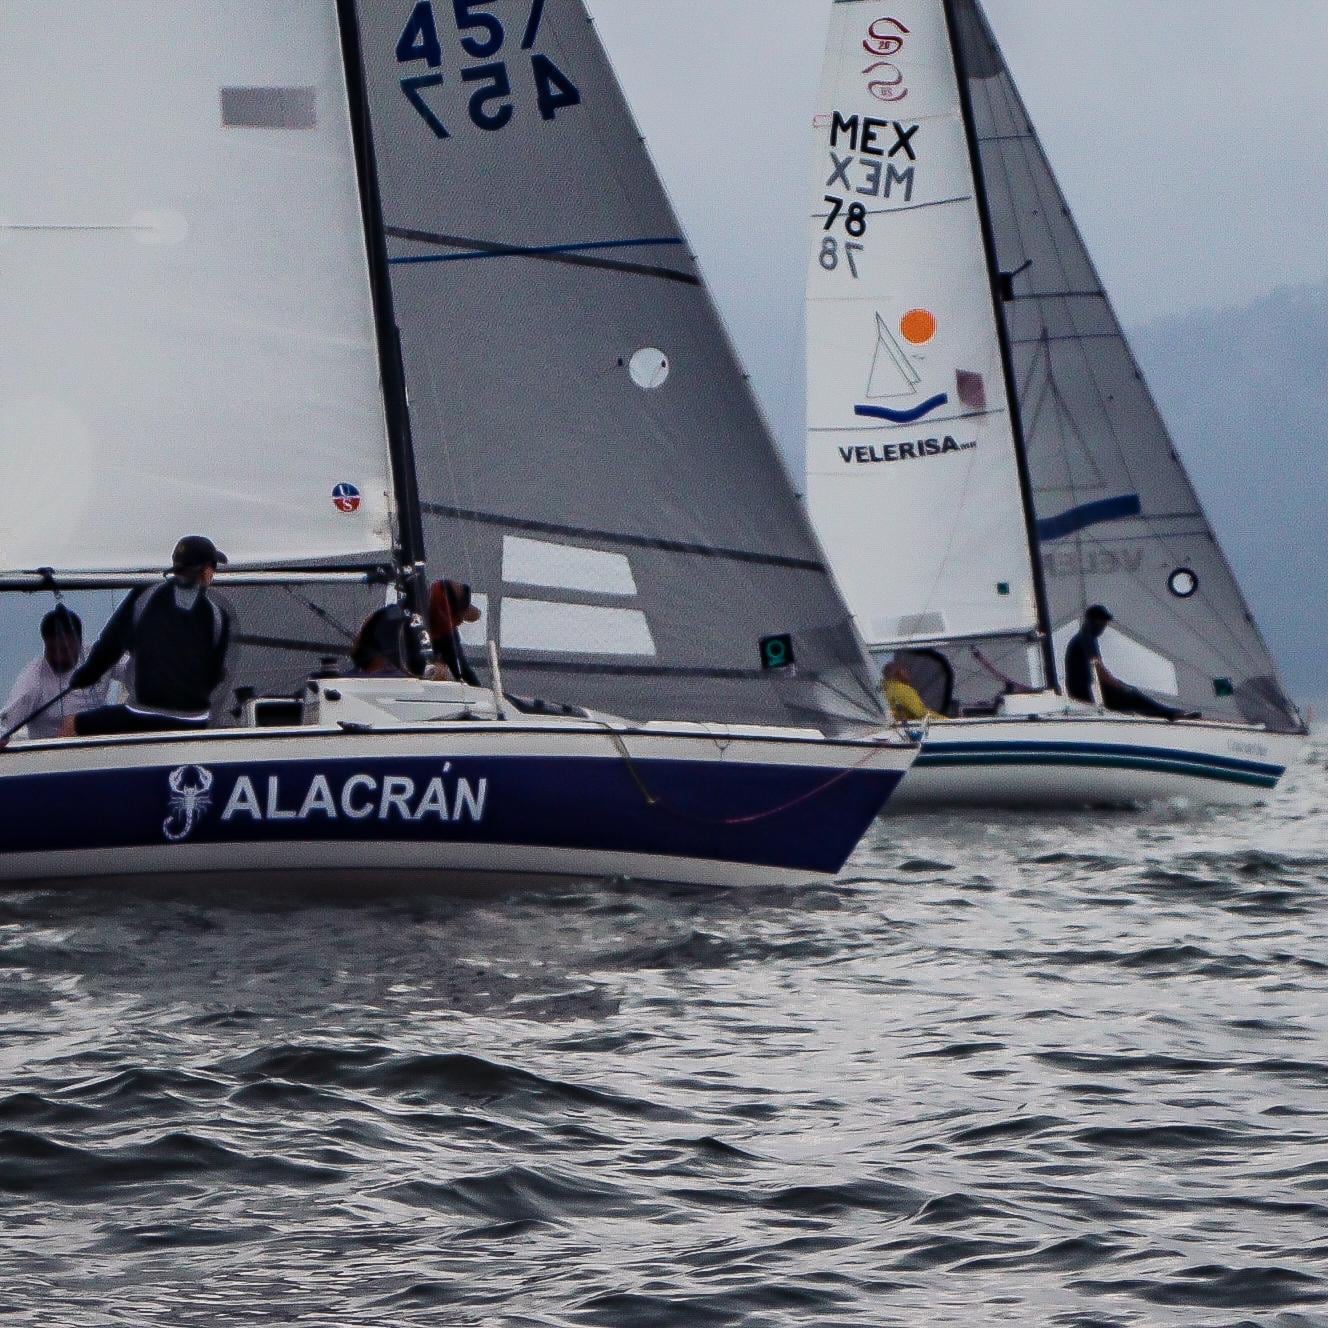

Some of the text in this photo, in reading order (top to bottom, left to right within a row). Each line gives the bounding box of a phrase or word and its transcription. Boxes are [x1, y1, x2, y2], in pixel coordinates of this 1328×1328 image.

[830, 110, 919, 160] MEX
[823, 194, 866, 237] 78
[838, 435, 961, 464] VELERISA
[221, 761, 487, 822] ALACRÁN
